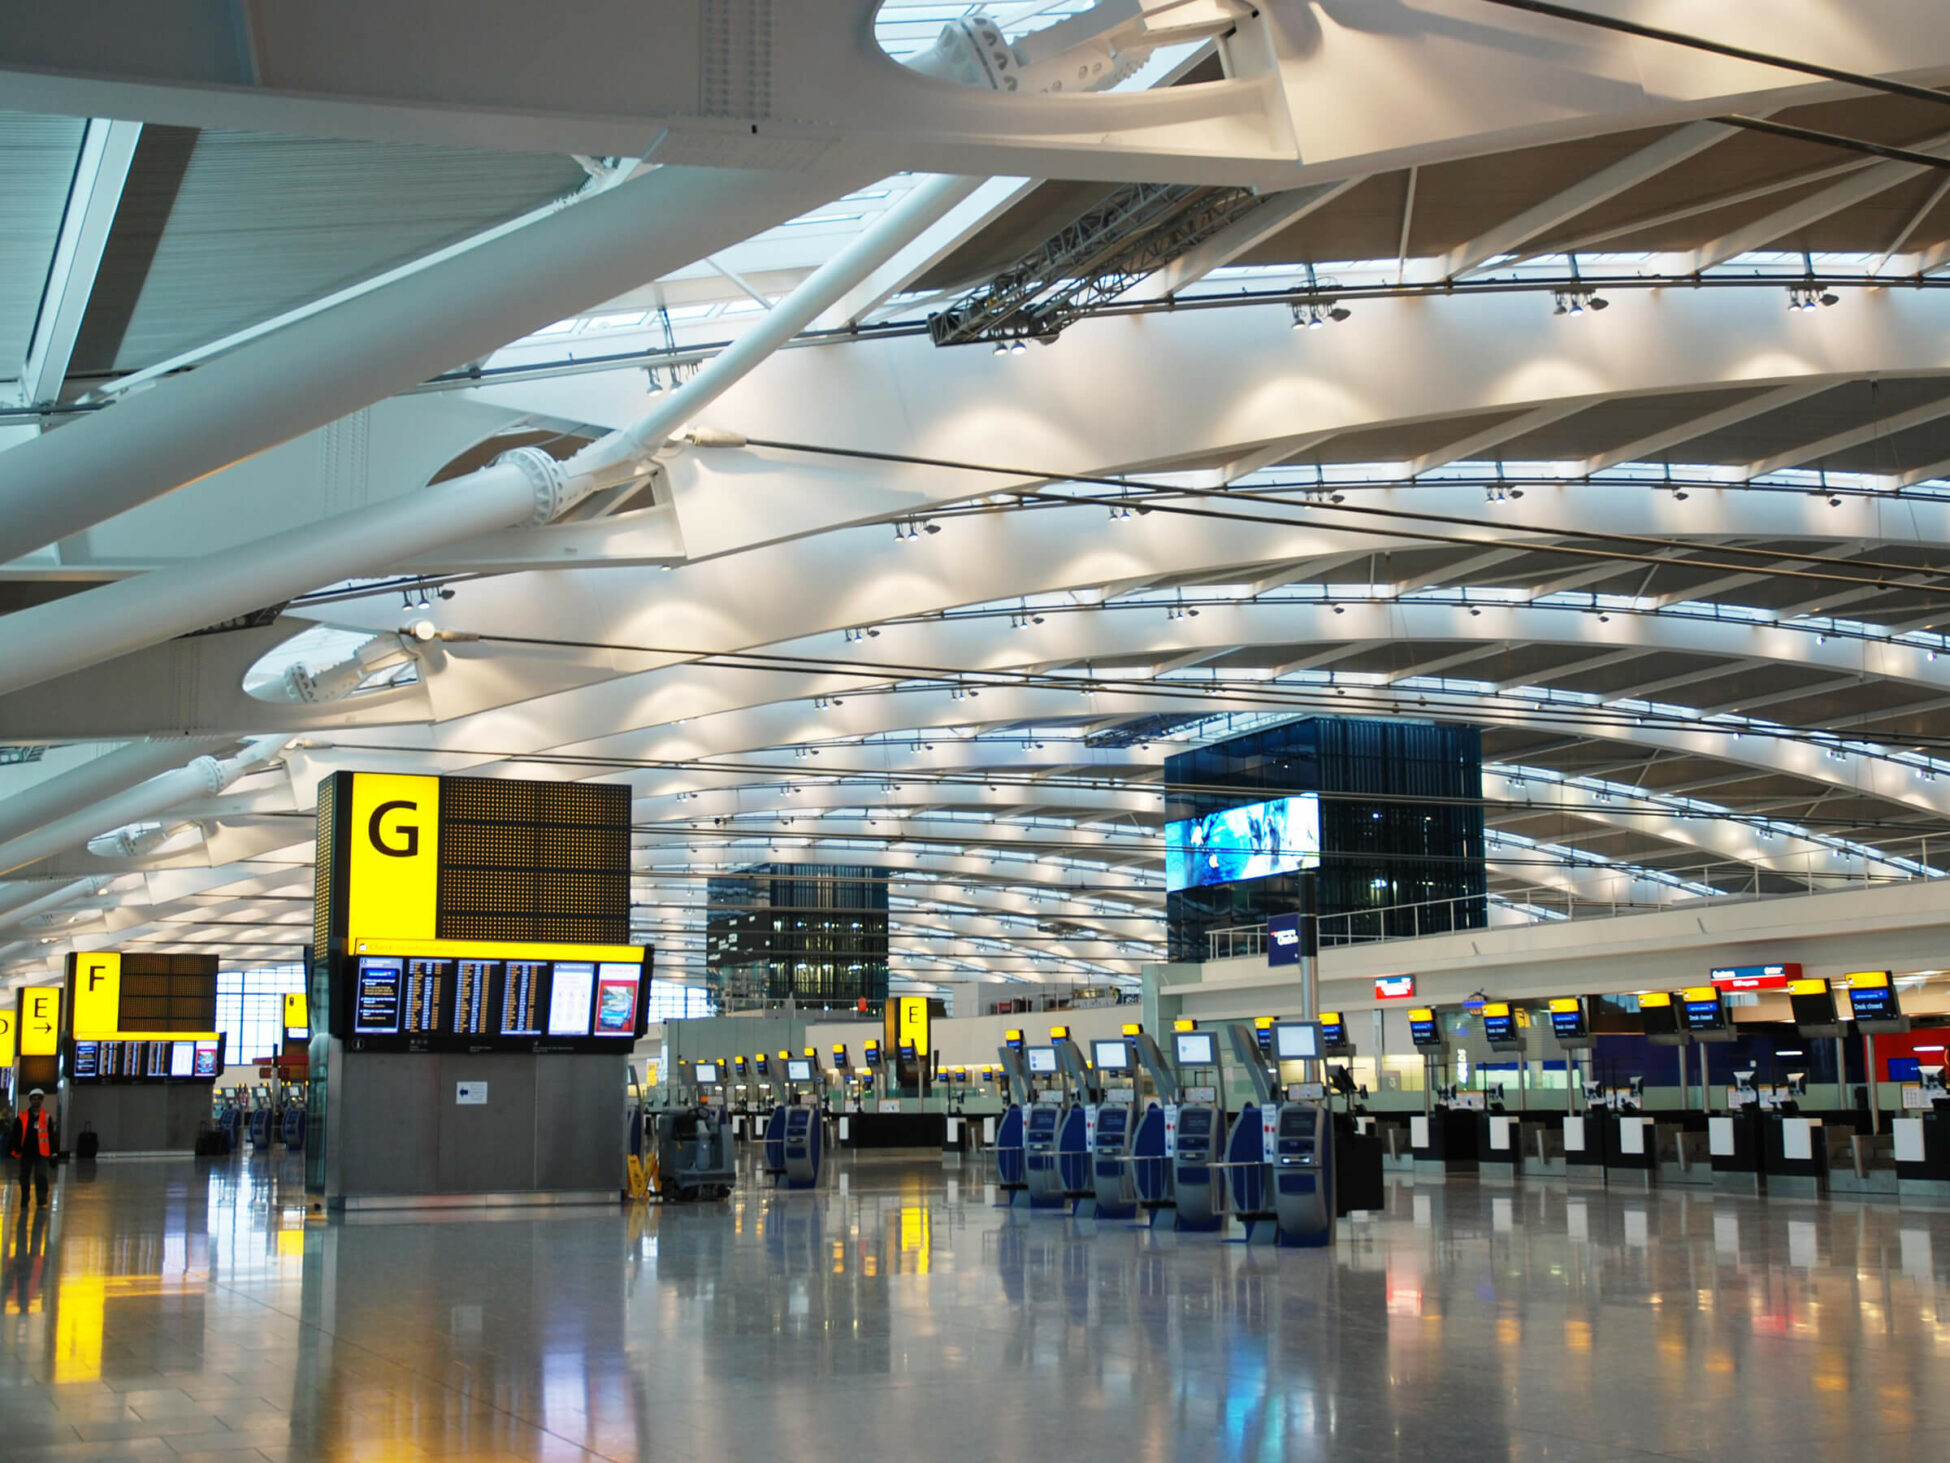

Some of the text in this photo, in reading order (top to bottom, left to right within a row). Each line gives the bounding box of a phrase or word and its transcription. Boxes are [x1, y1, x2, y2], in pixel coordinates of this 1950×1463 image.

[368, 800, 419, 858] G
[89, 965, 106, 992] F
[34, 997, 48, 1018] E
[909, 1006, 919, 1023] E
